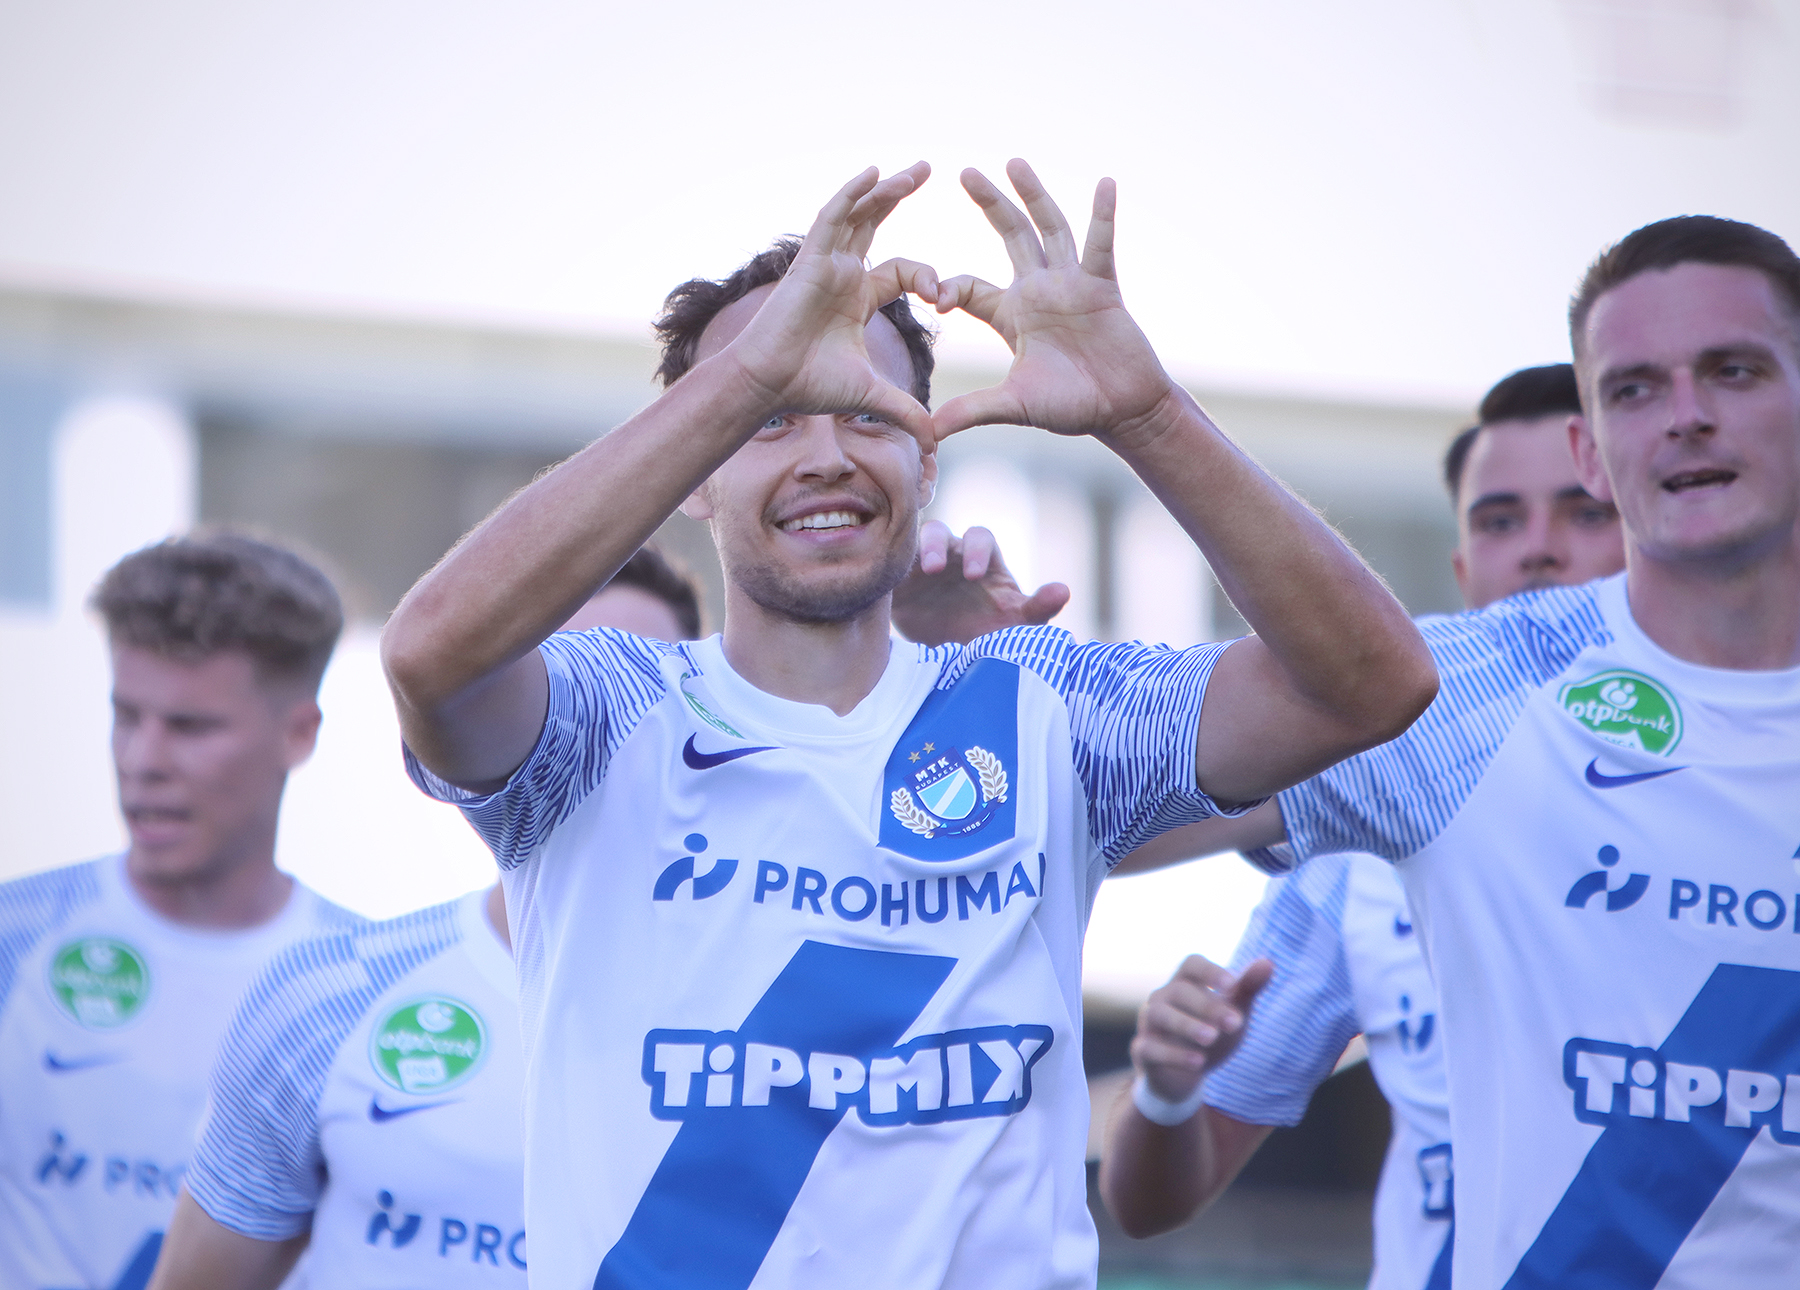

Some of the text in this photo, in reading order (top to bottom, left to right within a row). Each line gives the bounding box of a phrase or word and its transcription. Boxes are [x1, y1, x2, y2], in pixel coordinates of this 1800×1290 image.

[914, 757, 950, 782] MTK
[915, 762, 959, 791] BUDAPEST
[962, 821, 982, 834] 1888
[1668, 878, 1800, 934] PRO
[1575, 1050, 1800, 1134] TiPP
